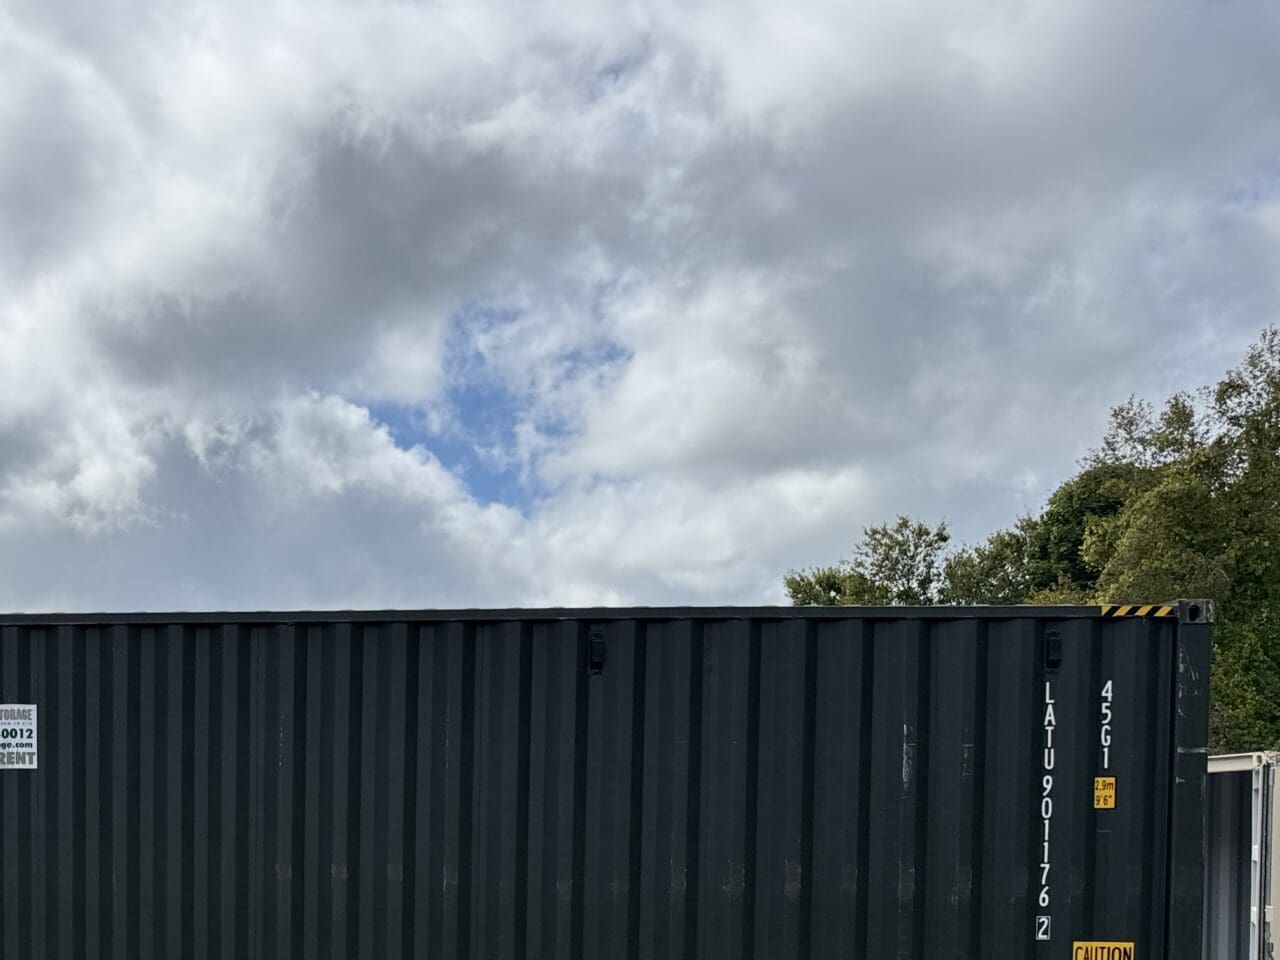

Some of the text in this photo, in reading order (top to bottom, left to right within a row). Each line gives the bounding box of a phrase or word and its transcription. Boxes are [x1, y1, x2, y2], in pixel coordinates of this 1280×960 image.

[1037, 681, 1056, 939] LATU 901176 2
[1101, 680, 1113, 769] 45G1
